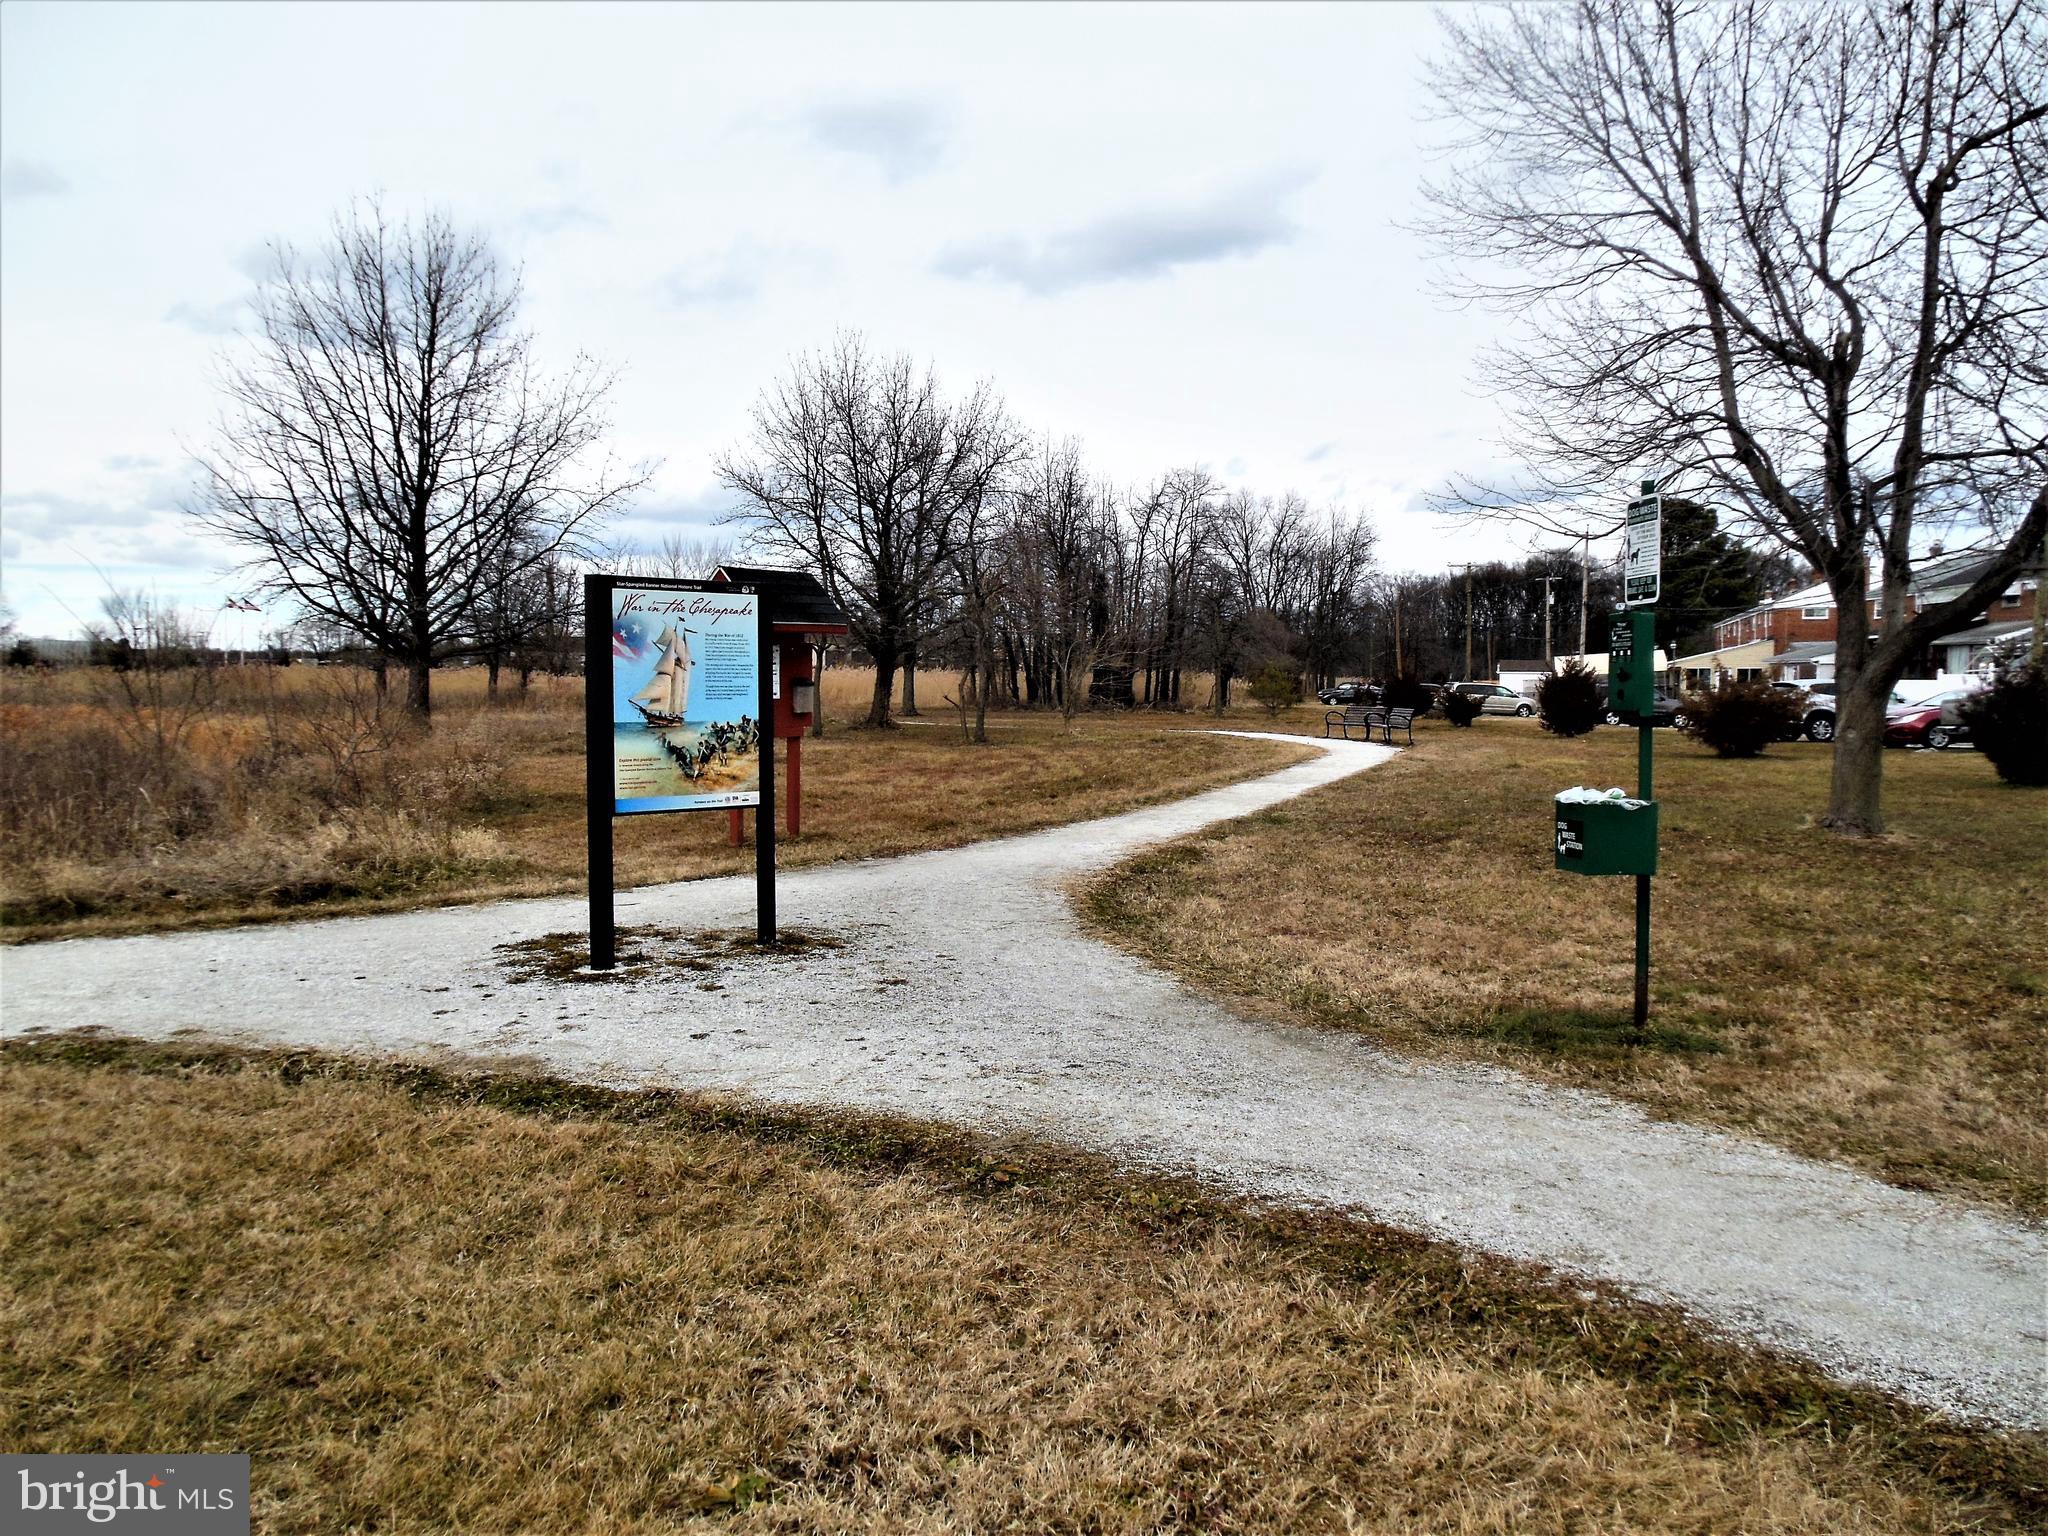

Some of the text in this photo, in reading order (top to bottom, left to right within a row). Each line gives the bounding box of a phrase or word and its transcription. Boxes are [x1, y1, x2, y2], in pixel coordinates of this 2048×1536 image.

[1628, 503, 1658, 518] DOG WASTE
[616, 593, 753, 625] War in the Chesapeake
[1557, 821, 1567, 829] DOG
[1562, 831, 1576, 840] WASTE
[1566, 840, 1583, 851] STATION
